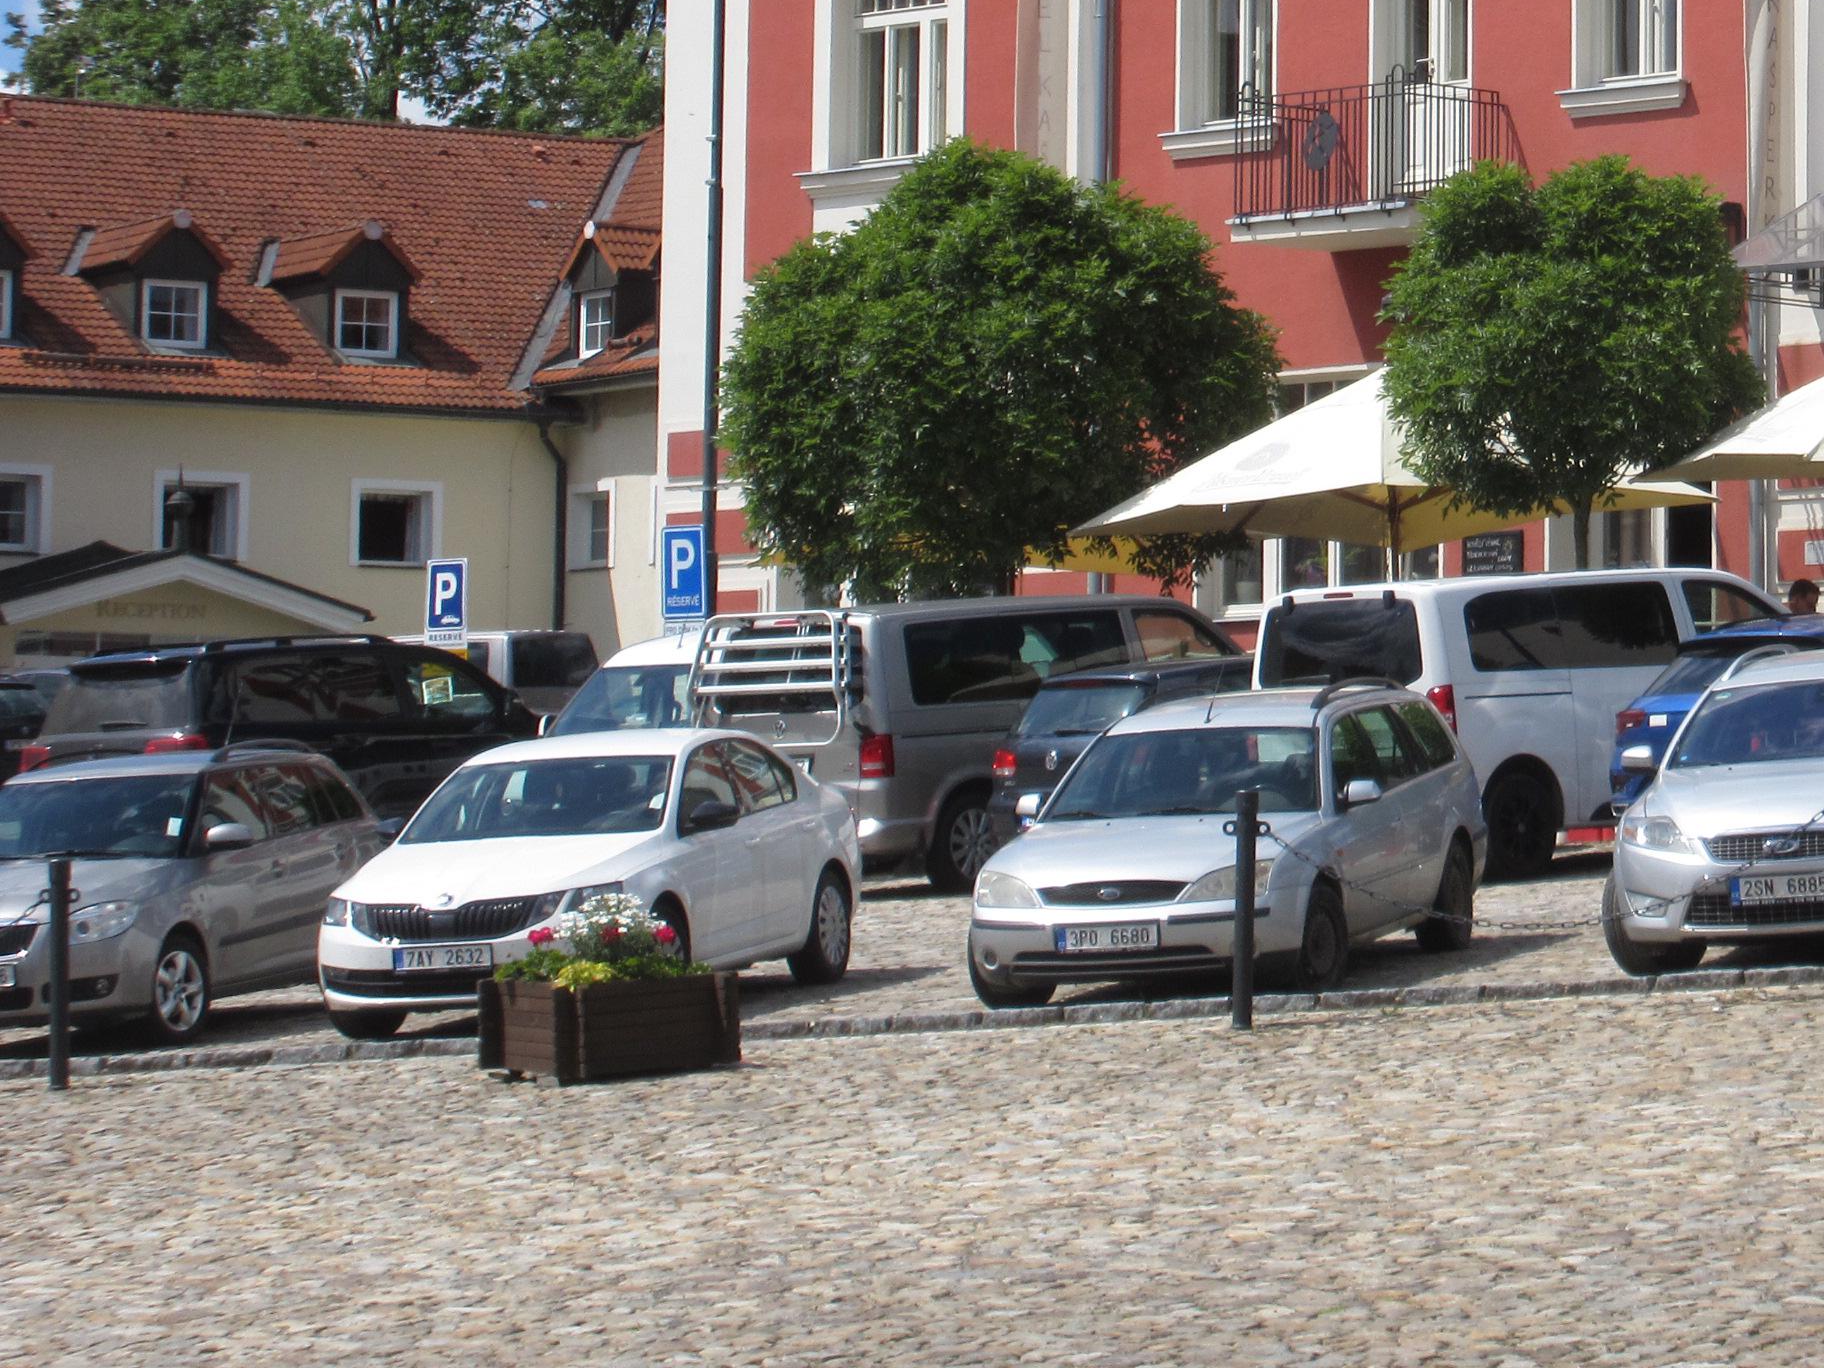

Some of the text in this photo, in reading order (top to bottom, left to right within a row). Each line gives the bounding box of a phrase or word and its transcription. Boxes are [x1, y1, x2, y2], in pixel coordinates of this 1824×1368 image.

[671, 539, 695, 589] P
[434, 572, 457, 616] P
[1743, 879, 1774, 897] 2SN
[1110, 928, 1150, 945] 6680
[407, 948, 483, 967] 7AY 2632
